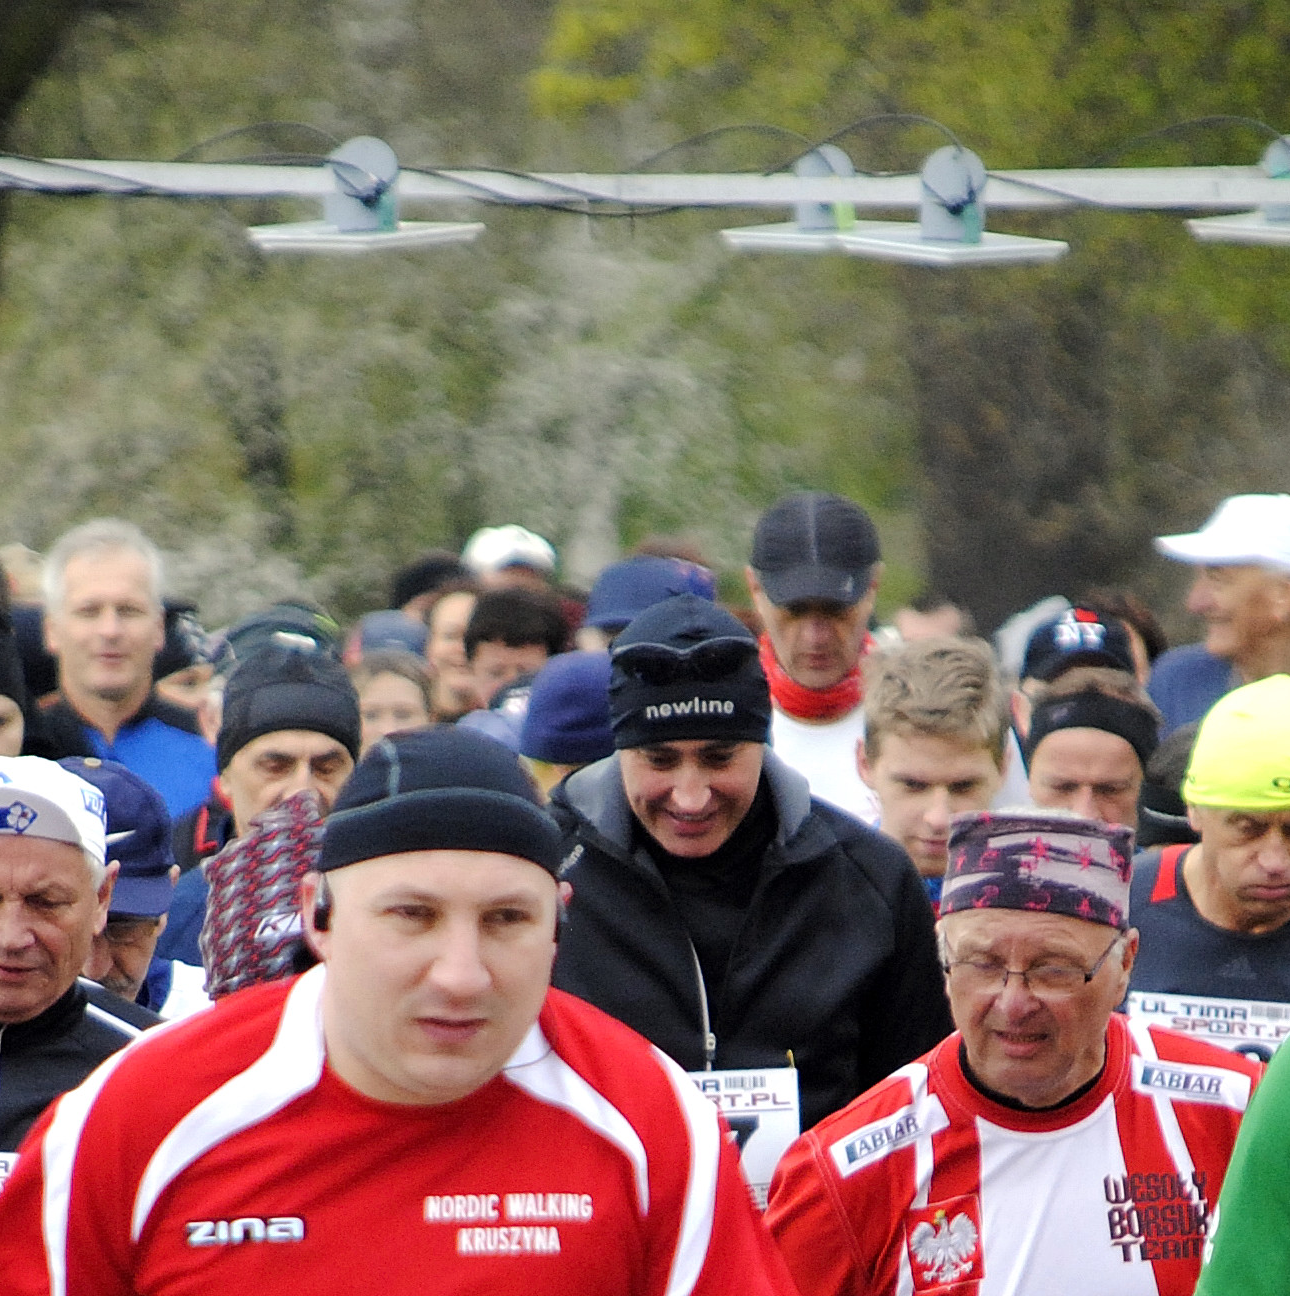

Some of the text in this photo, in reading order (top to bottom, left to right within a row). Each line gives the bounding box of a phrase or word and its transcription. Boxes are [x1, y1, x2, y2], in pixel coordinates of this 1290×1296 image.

[646, 696, 734, 719] newline
[1141, 999, 1248, 1019] ULTIMA
[423, 1192, 594, 1223] NORDIC WALKING
[457, 1226, 561, 1257] KRUSZYNA
